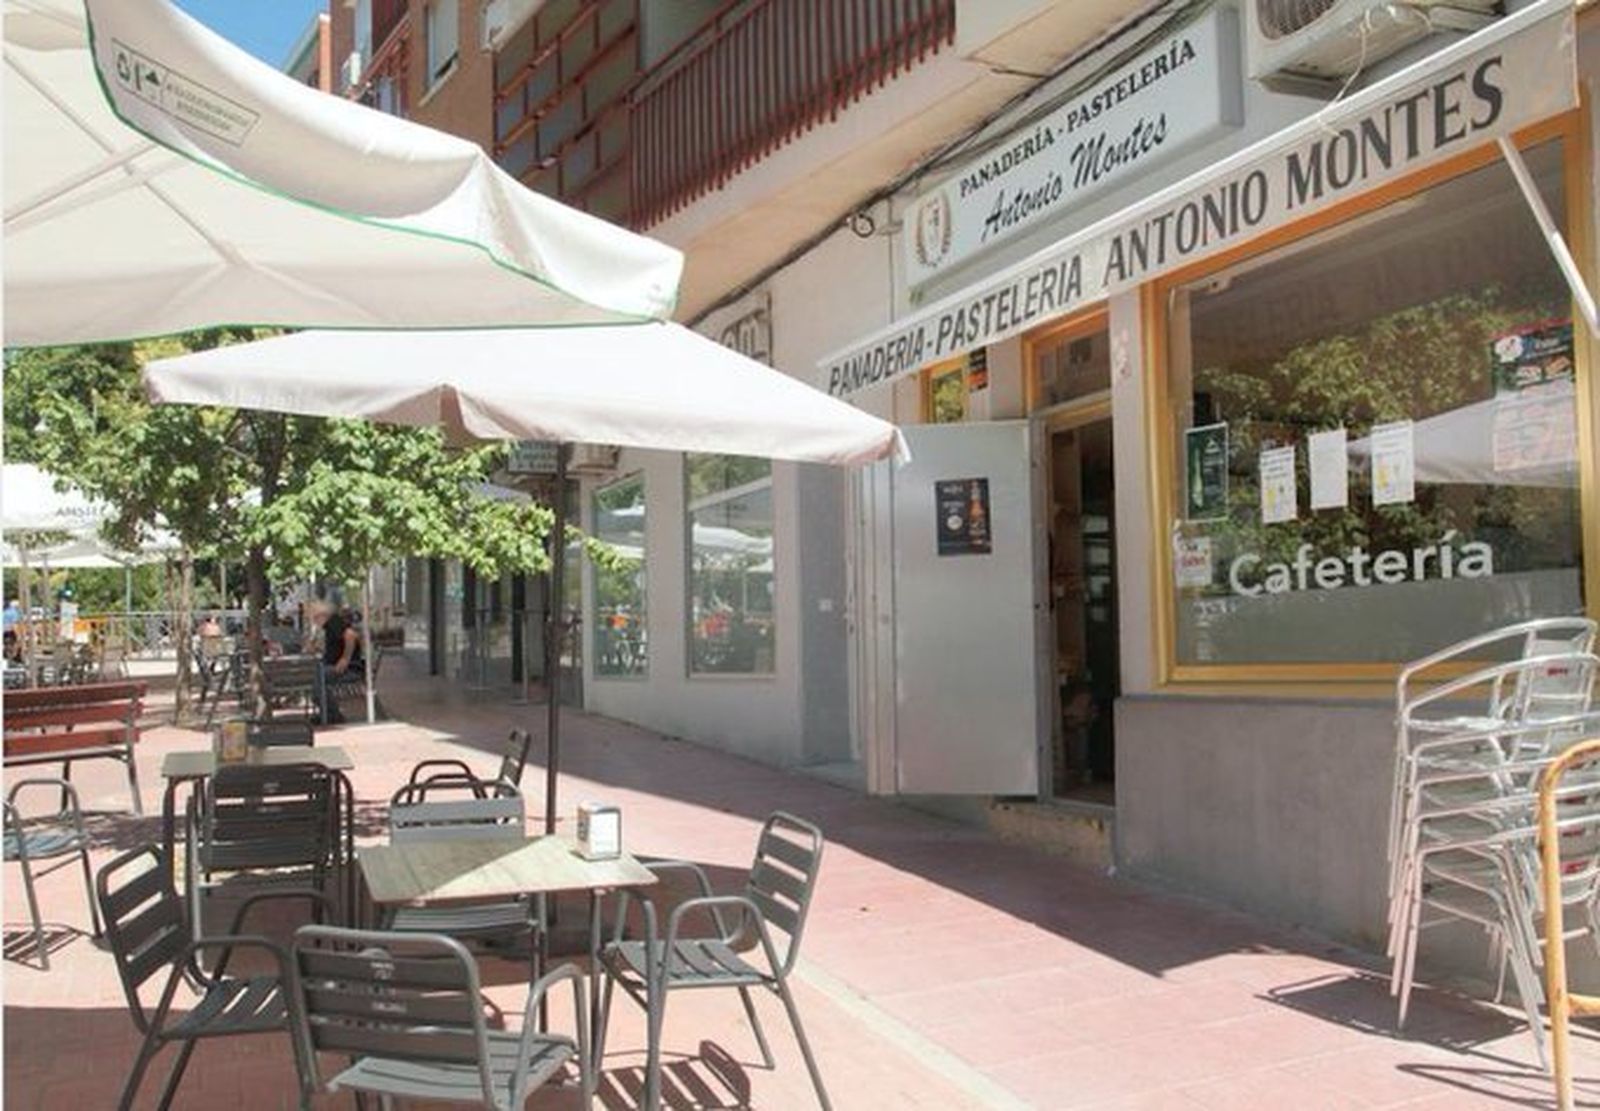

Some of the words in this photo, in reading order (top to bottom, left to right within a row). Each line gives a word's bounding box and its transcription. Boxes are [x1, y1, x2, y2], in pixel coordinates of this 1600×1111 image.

[959, 126, 1054, 197] PANADERÍA
[1067, 39, 1196, 133] PASTELERÍA
[981, 171, 1062, 242] Antonio
[1070, 113, 1166, 188] Montes
[1103, 170, 1268, 287] ANTONIO
[1286, 56, 1504, 209] MONTES
[1230, 529, 1492, 598] Cafetería
